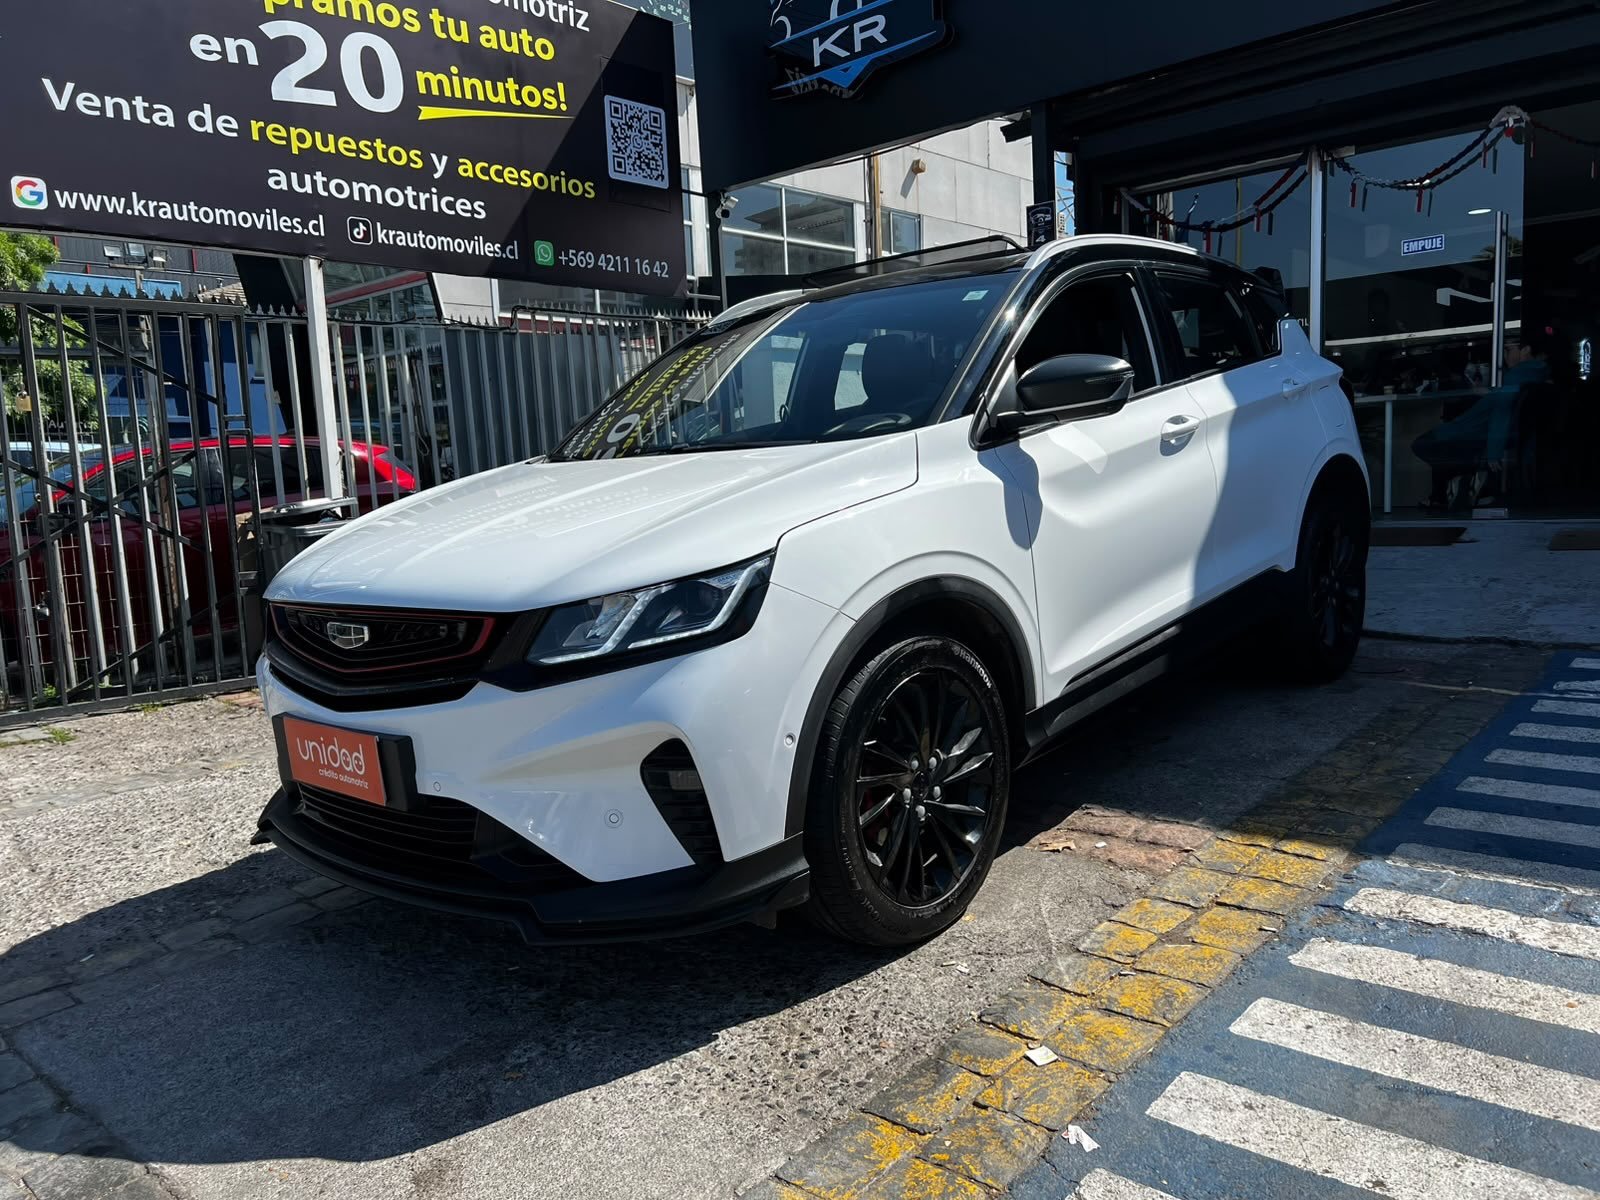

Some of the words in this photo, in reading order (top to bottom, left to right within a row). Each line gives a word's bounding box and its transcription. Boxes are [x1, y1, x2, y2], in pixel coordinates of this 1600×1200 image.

[429, 8, 470, 44] tu
[479, 25, 555, 61] auto
[812, 14, 888, 67] KR
[189, 33, 259, 66] en
[258, 20, 404, 113] 20
[415, 66, 568, 112] minutos!
[41, 77, 175, 128] Venta
[187, 104, 239, 138] de
[250, 119, 424, 169] repuestos
[429, 152, 449, 179] y
[457, 156, 596, 199] accesorios
[54, 189, 326, 237] www.krautomoviles.cl
[267, 168, 487, 219] automotrices
[376, 222, 520, 261] krautomoviles.cl
[558, 249, 595, 269] +569
[598, 253, 630, 273] 4211
[635, 258, 651, 276] 16
[653, 261, 670, 278] 42
[1403, 237, 1442, 253] EMPUJE
[296, 736, 366, 776] unidad
[338, 773, 369, 790] automotriz
